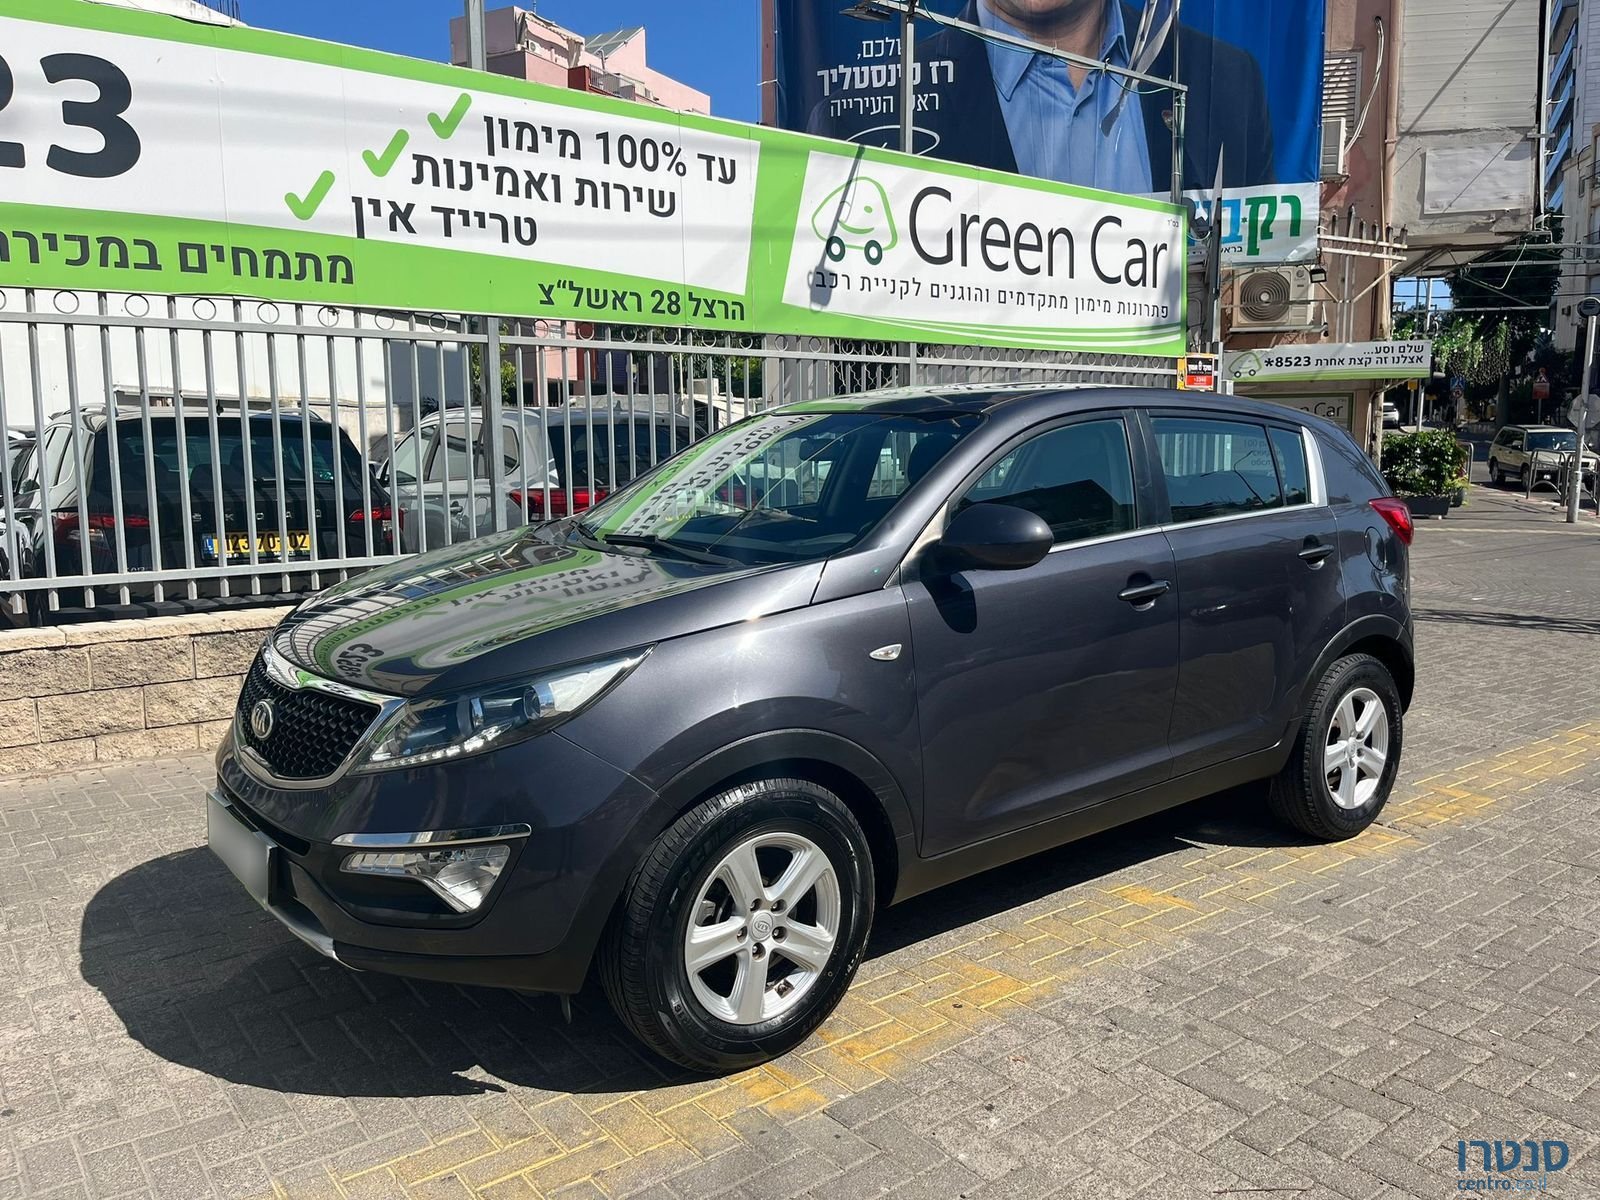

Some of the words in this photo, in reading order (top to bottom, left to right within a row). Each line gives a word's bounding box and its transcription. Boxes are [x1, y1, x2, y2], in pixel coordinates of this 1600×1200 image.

[929, 61, 954, 85] רז
[830, 96, 894, 117] העירייה
[912, 93, 939, 112] רא
[483, 115, 582, 160] מימון
[595, 131, 687, 177] 100%
[411, 153, 561, 203] ואמינות
[696, 152, 737, 185] עד
[574, 177, 676, 218] שירות
[351, 196, 417, 239] אין
[431, 205, 538, 246] טרייד
[1245, 195, 1302, 256] רק
[909, 186, 1075, 279] Green
[1090, 216, 1168, 288] Car
[178, 241, 354, 285] מתמחים
[815, 270, 852, 291] רכב
[860, 274, 922, 300] לקניית
[650, 289, 682, 315] 28
[930, 283, 990, 304] והוגנים
[998, 289, 1068, 309] מתקדמים
[688, 292, 745, 321] הרצל
[1075, 298, 1111, 316] מימון
[1117, 301, 1169, 319] פתרונות
[1376, 356, 1388, 364] זה
[1392, 354, 1424, 364] אצלנו
[1398, 344, 1424, 354] שלם
[1315, 358, 1345, 367] אחרת
[1349, 357, 1372, 367] קצת
[1314, 402, 1343, 417] Car
